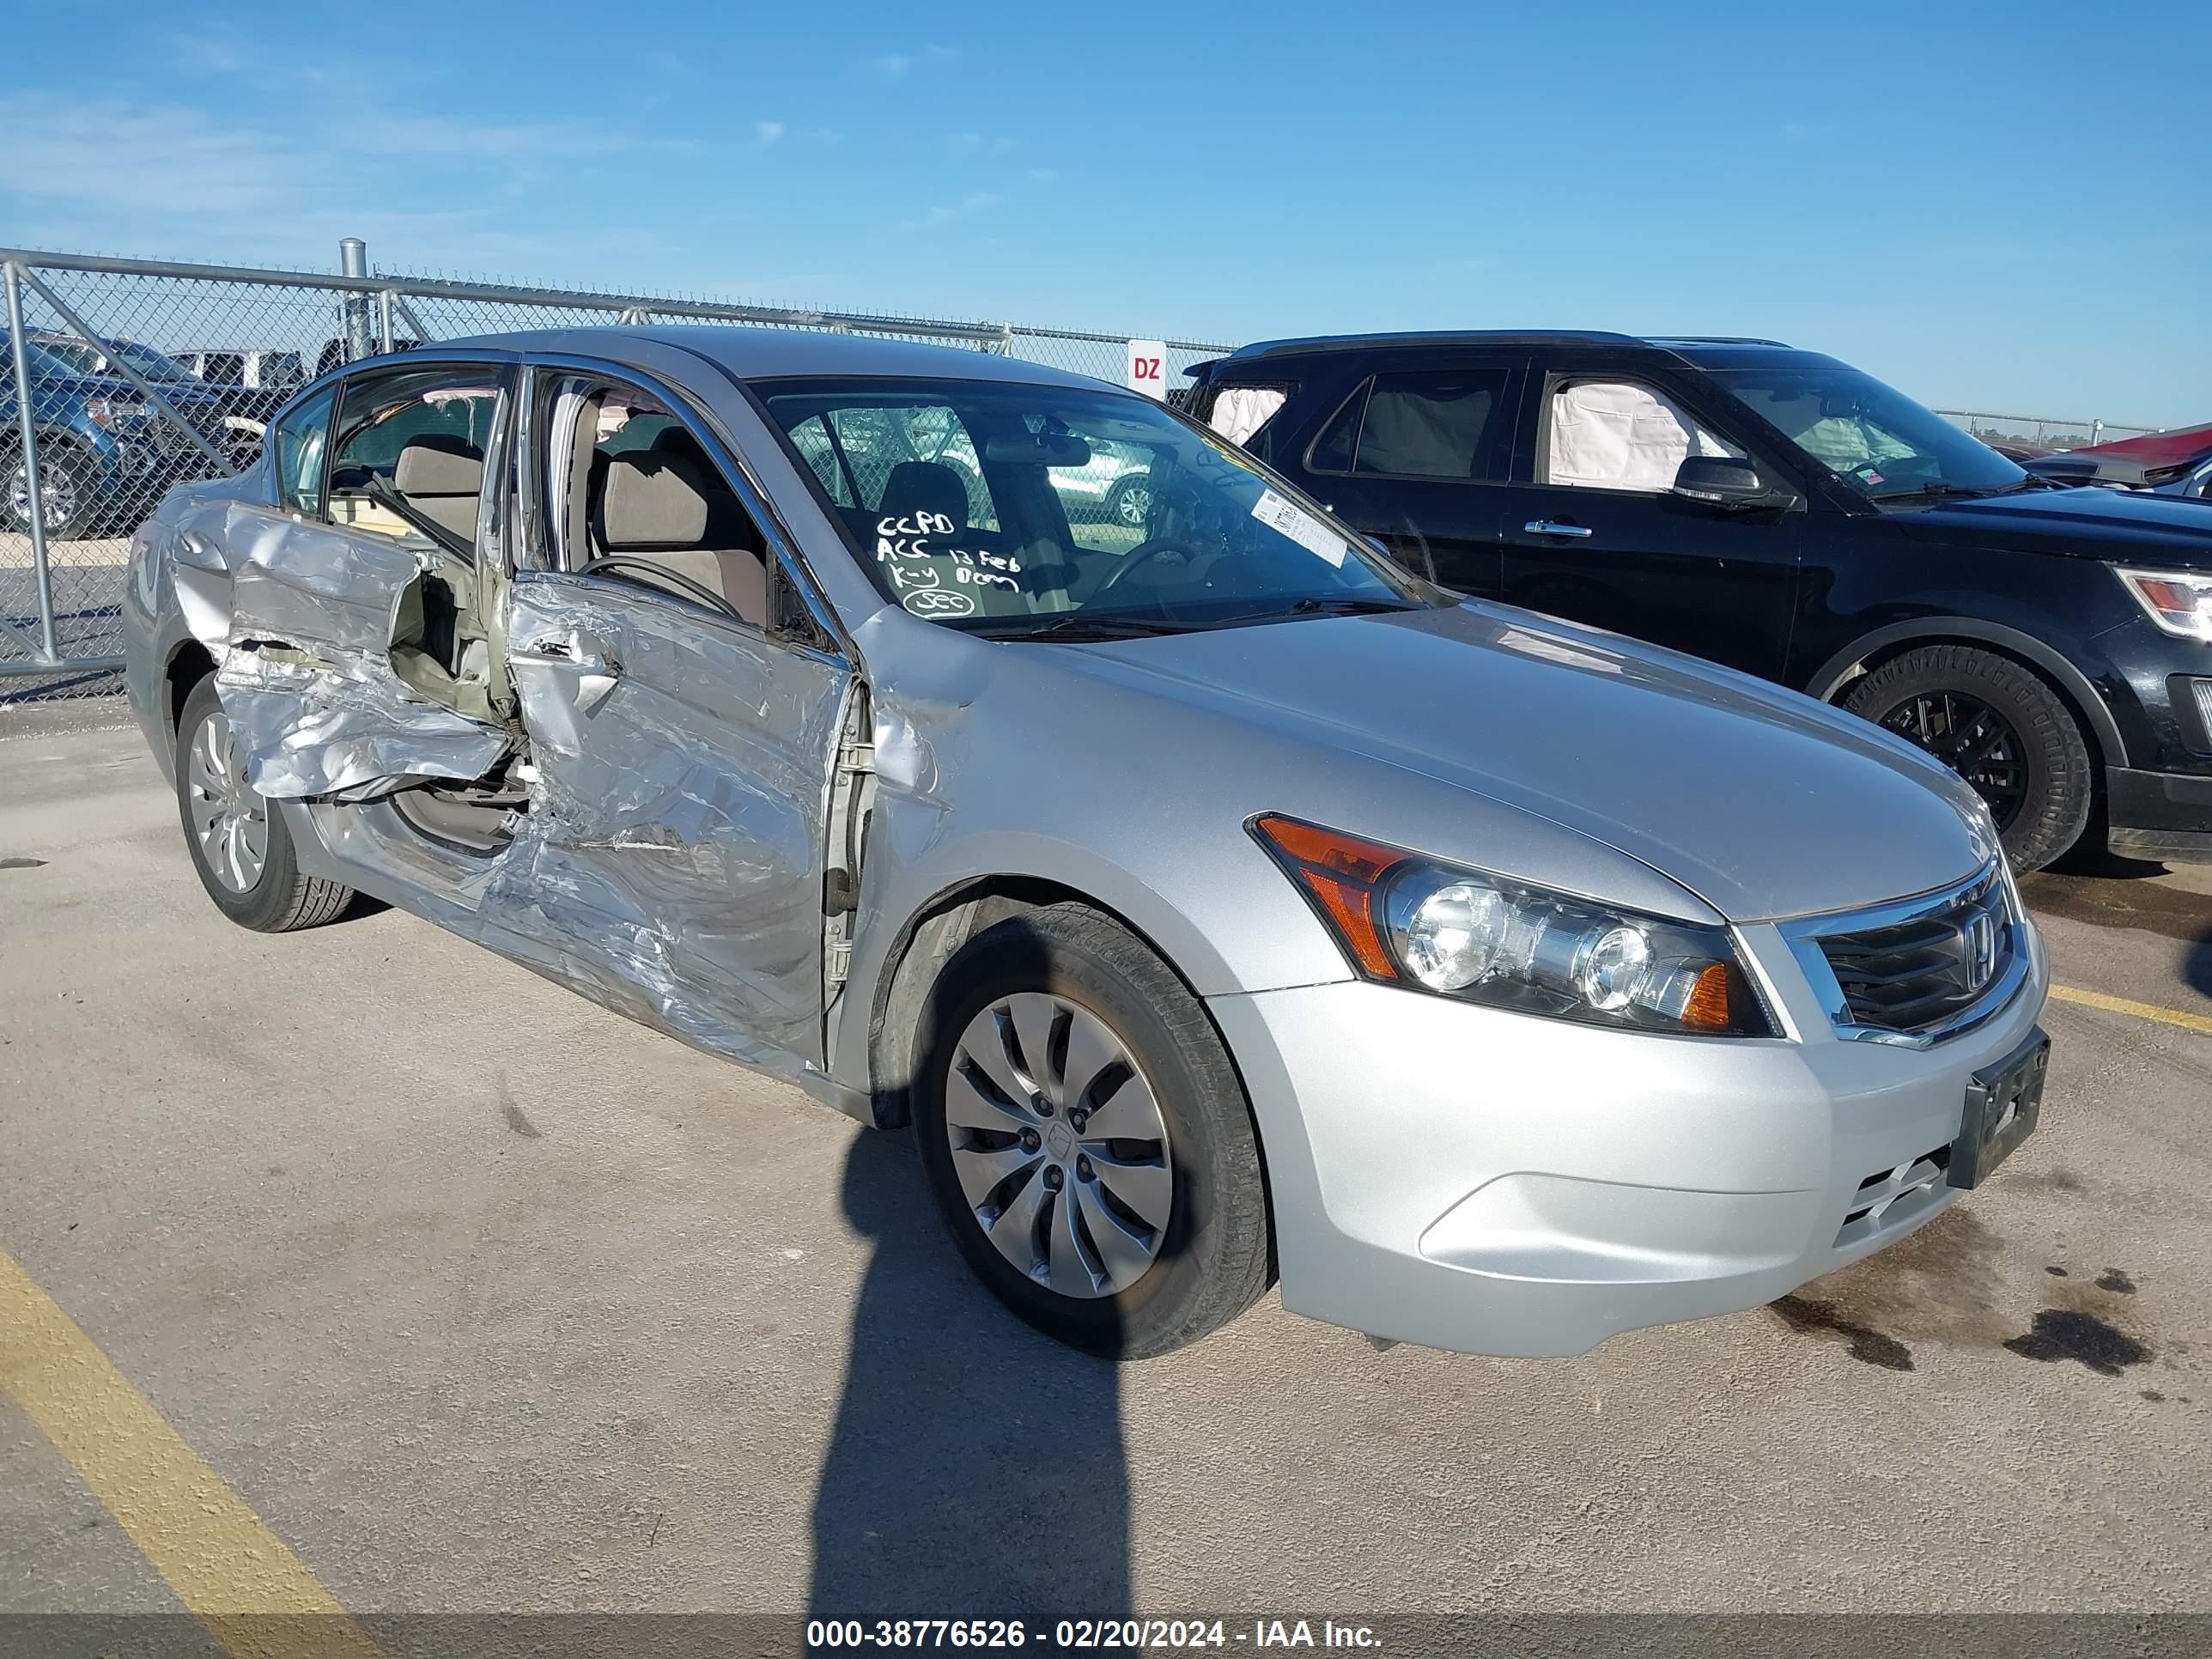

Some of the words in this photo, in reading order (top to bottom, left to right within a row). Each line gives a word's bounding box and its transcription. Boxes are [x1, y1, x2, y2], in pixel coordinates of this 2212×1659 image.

[1134, 357, 1160, 380] DZ
[877, 511, 955, 536] CCPD
[877, 538, 931, 561] ACC
[949, 550, 974, 565] 13
